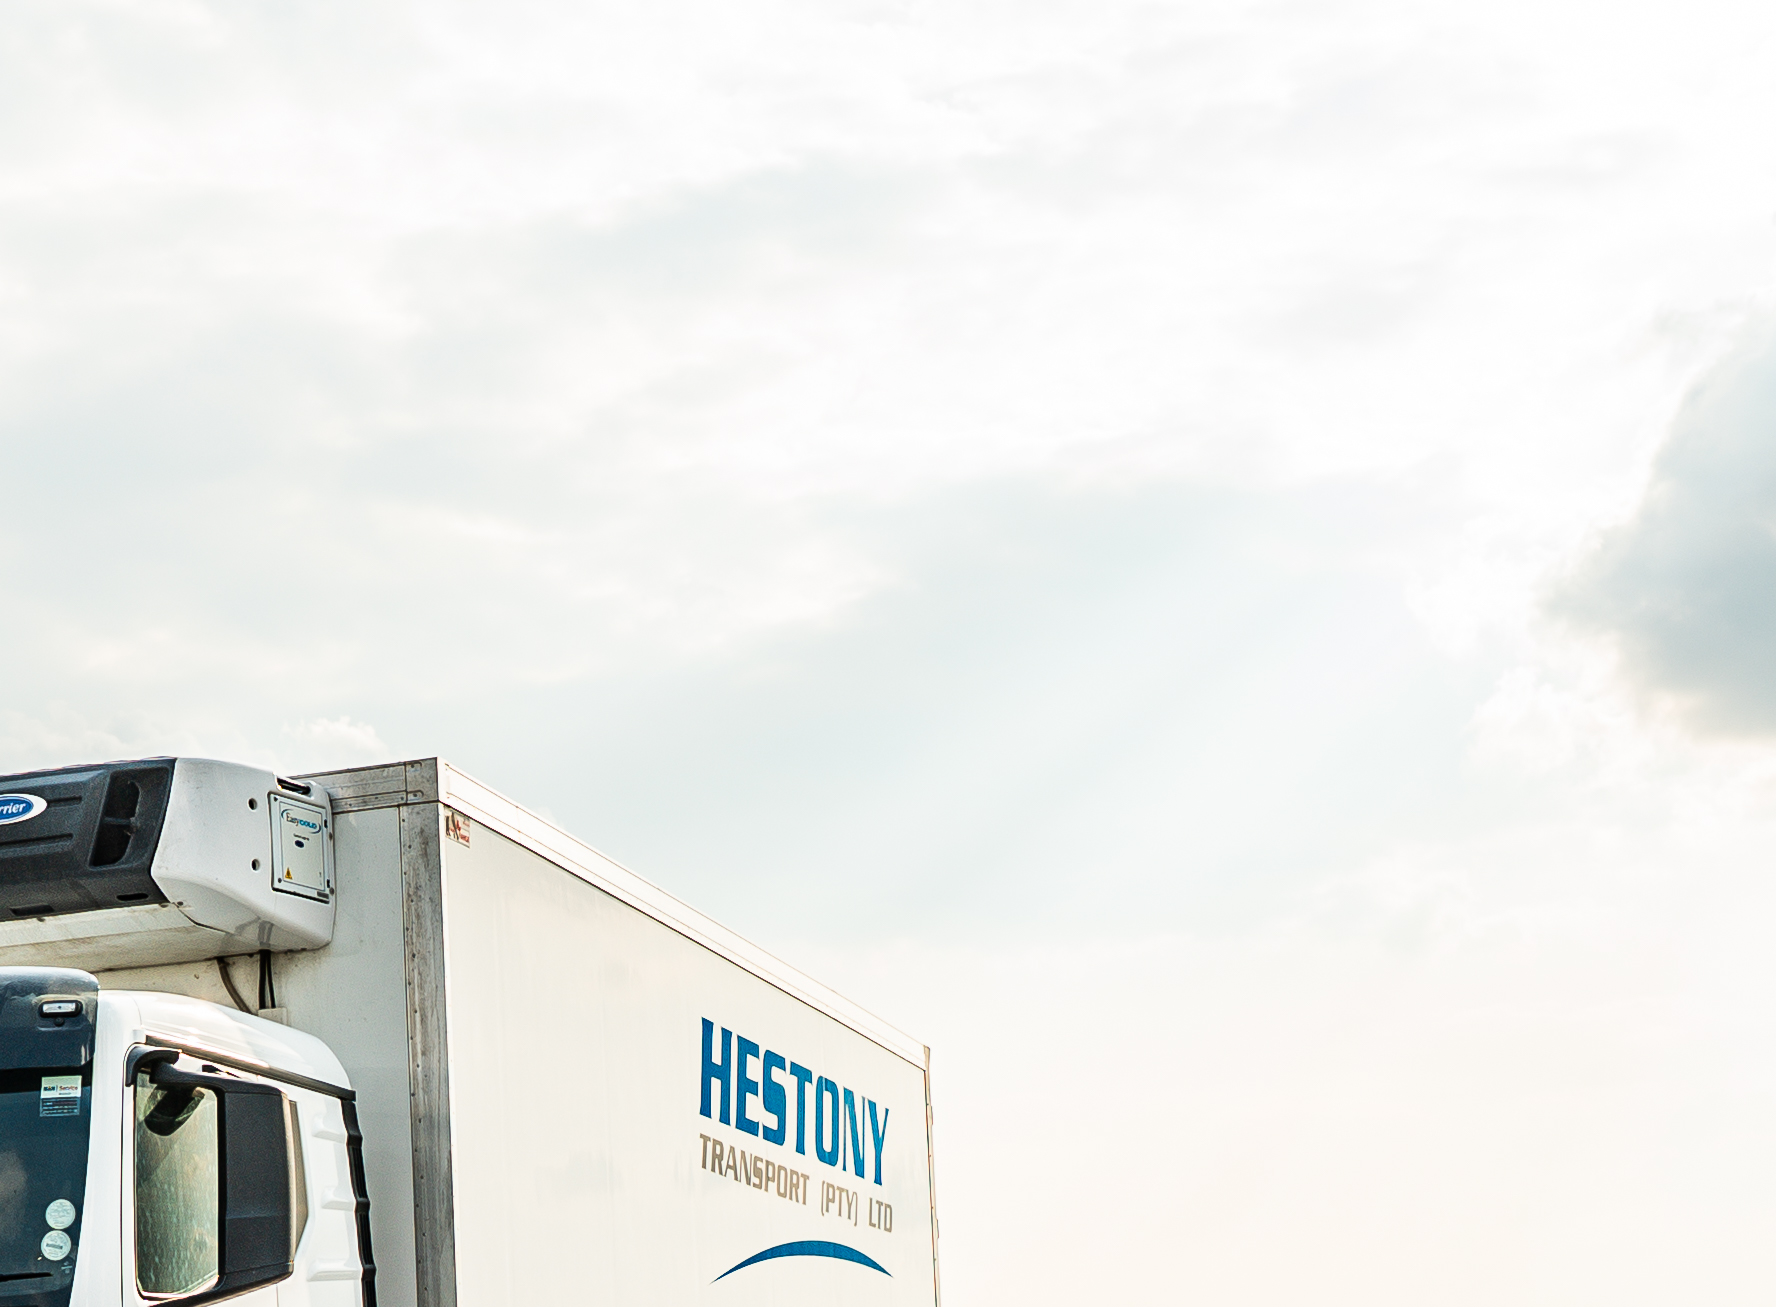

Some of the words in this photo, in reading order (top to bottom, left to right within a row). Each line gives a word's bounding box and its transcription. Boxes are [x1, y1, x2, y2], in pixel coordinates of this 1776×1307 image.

[699, 1016, 890, 1186] HESTONY
[699, 1132, 810, 1206] TRANSPORT
[820, 1180, 859, 1227] (PTY)
[868, 1197, 893, 1233] LTD
